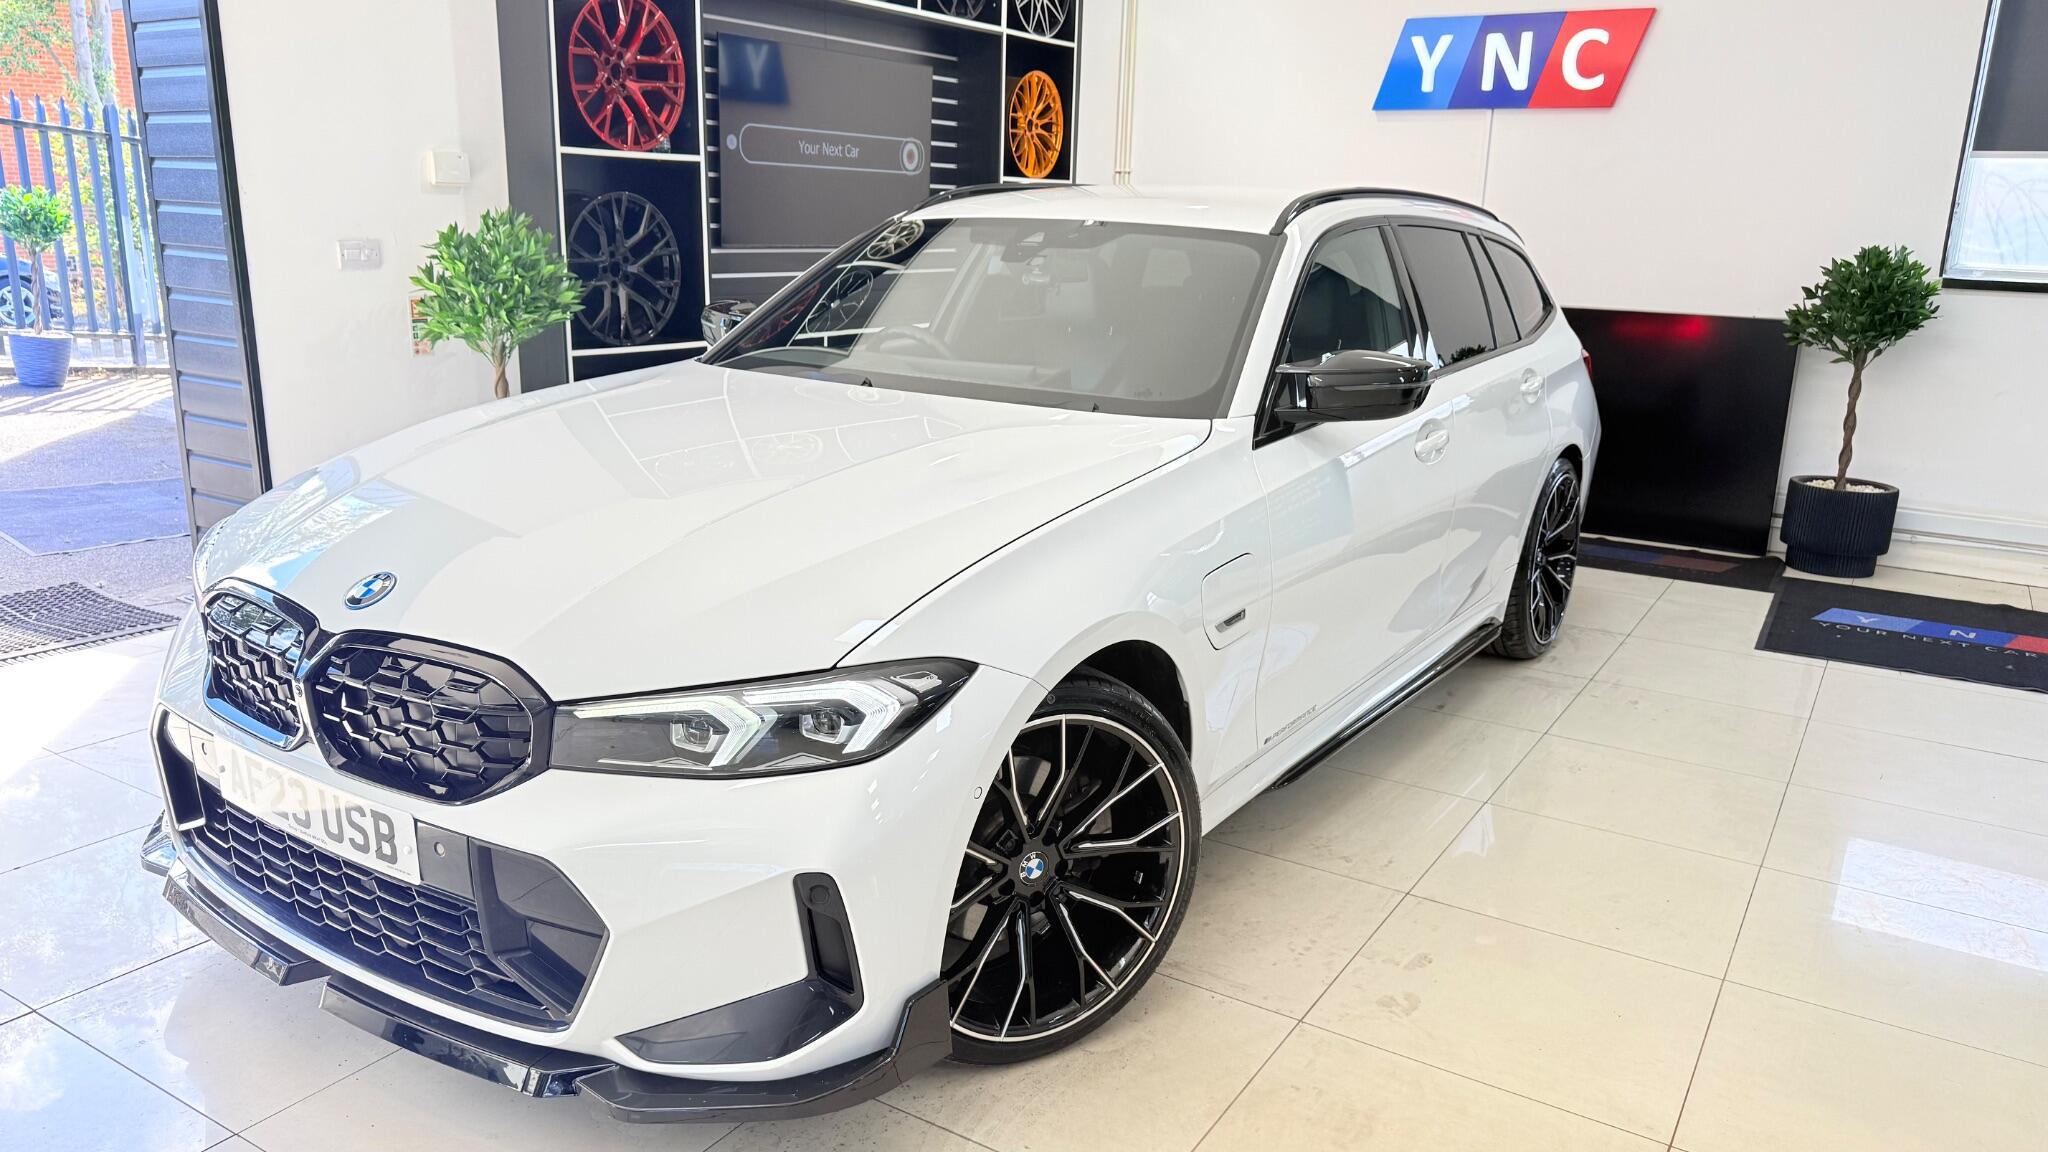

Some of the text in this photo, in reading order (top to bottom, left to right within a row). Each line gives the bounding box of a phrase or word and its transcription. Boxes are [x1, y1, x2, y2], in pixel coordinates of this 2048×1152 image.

[1411, 28, 1609, 92] YNC
[798, 140, 860, 158] Your Next Car
[1819, 622, 2038, 658] YOUR NEXT CAR
[318, 788, 398, 866] USB
